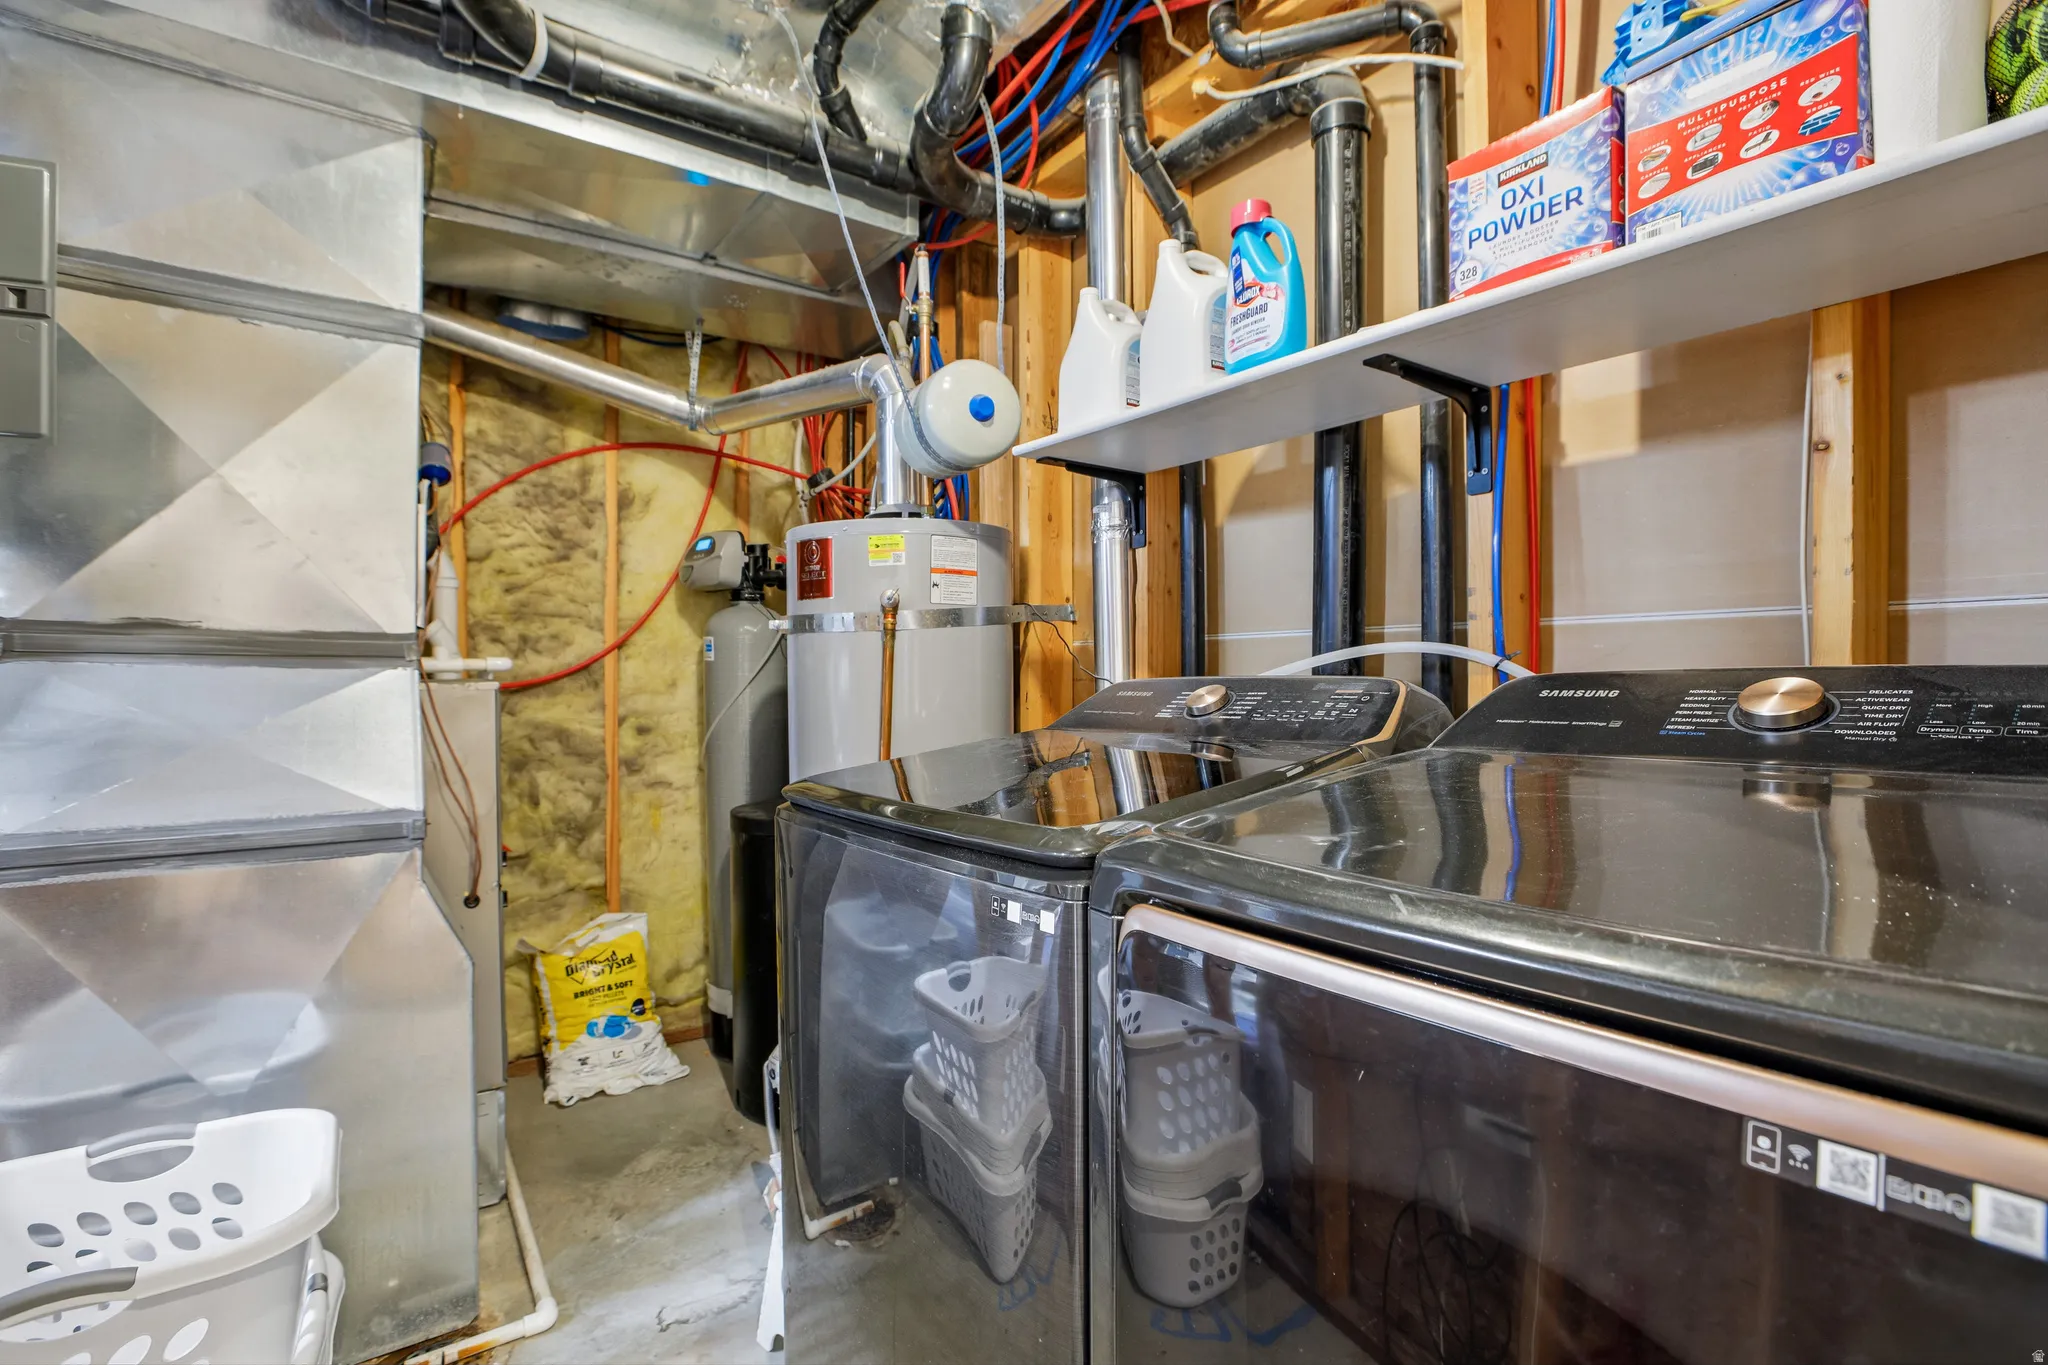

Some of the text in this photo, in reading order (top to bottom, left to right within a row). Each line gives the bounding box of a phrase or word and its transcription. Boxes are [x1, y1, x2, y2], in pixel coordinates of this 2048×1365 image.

[1799, 66, 1841, 87] RED WINE
[1677, 76, 1789, 131] MULTIPURPOSE
[1737, 91, 1782, 113] PET STAINS
[1806, 100, 1834, 114] GROUT
[1682, 114, 1727, 136] UPHOLSTERY
[1747, 125, 1772, 137] PATIO
[1639, 139, 1669, 154] LAUNDRY
[1683, 142, 1727, 163] APPLIANCES
[1499, 153, 1548, 183] KIRKLAND
[1640, 166, 1669, 181] CARPETS
[1501, 175, 1544, 211] OXI
[1468, 185, 1584, 250] POWDER
[1488, 219, 1559, 251] LAUNDRY BOOSTER
[1499, 227, 1555, 251] MULTIPURPOSE
[1517, 235, 1553, 252] REMOVER
[1459, 265, 1478, 282] 328
[1236, 285, 1260, 305] CLOROX
[1230, 302, 1268, 328] FRESHGUARD
[1539, 689, 1620, 698] SAMSUNG
[573, 985, 605, 999] BRIGHT
[614, 980, 633, 990] SOFT
